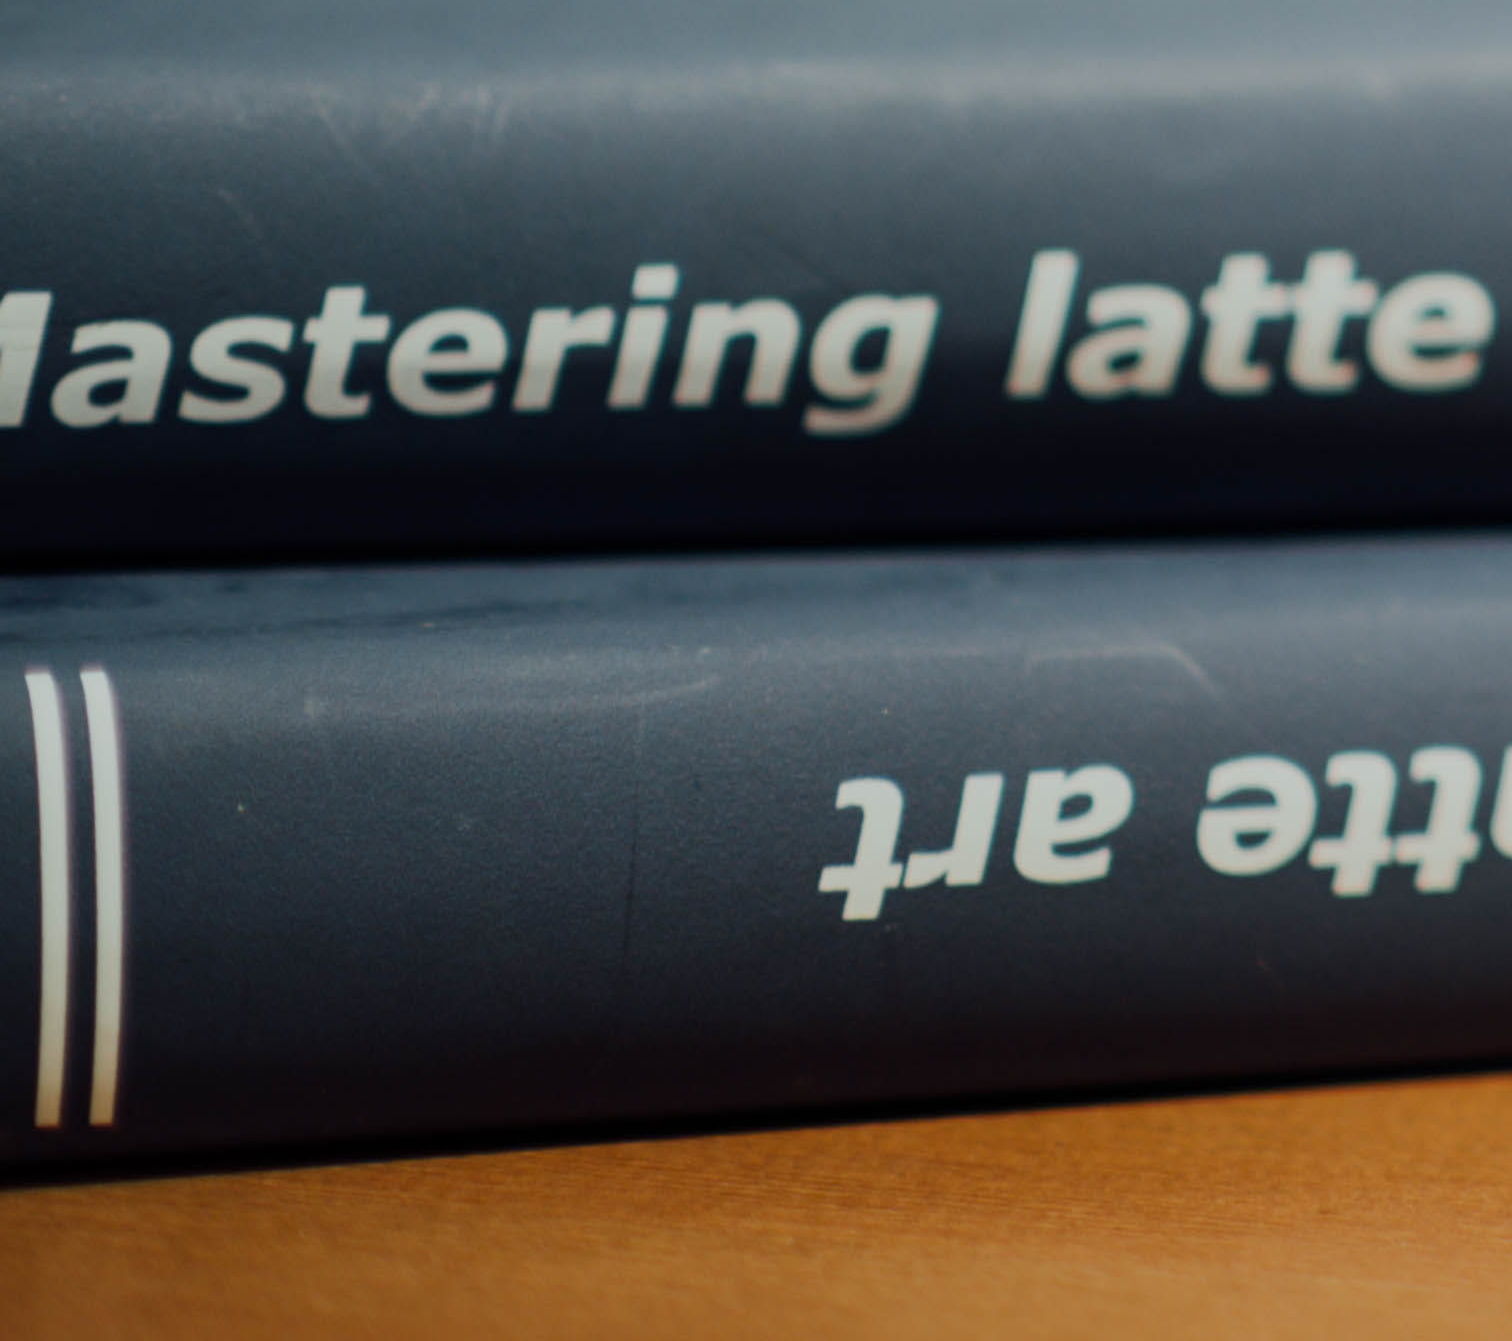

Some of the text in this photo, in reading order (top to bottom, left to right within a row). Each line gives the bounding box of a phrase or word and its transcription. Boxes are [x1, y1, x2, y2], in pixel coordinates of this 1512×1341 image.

[0, 262, 938, 435] astering
[1006, 249, 1495, 398] latte
[817, 763, 1135, 922] art
